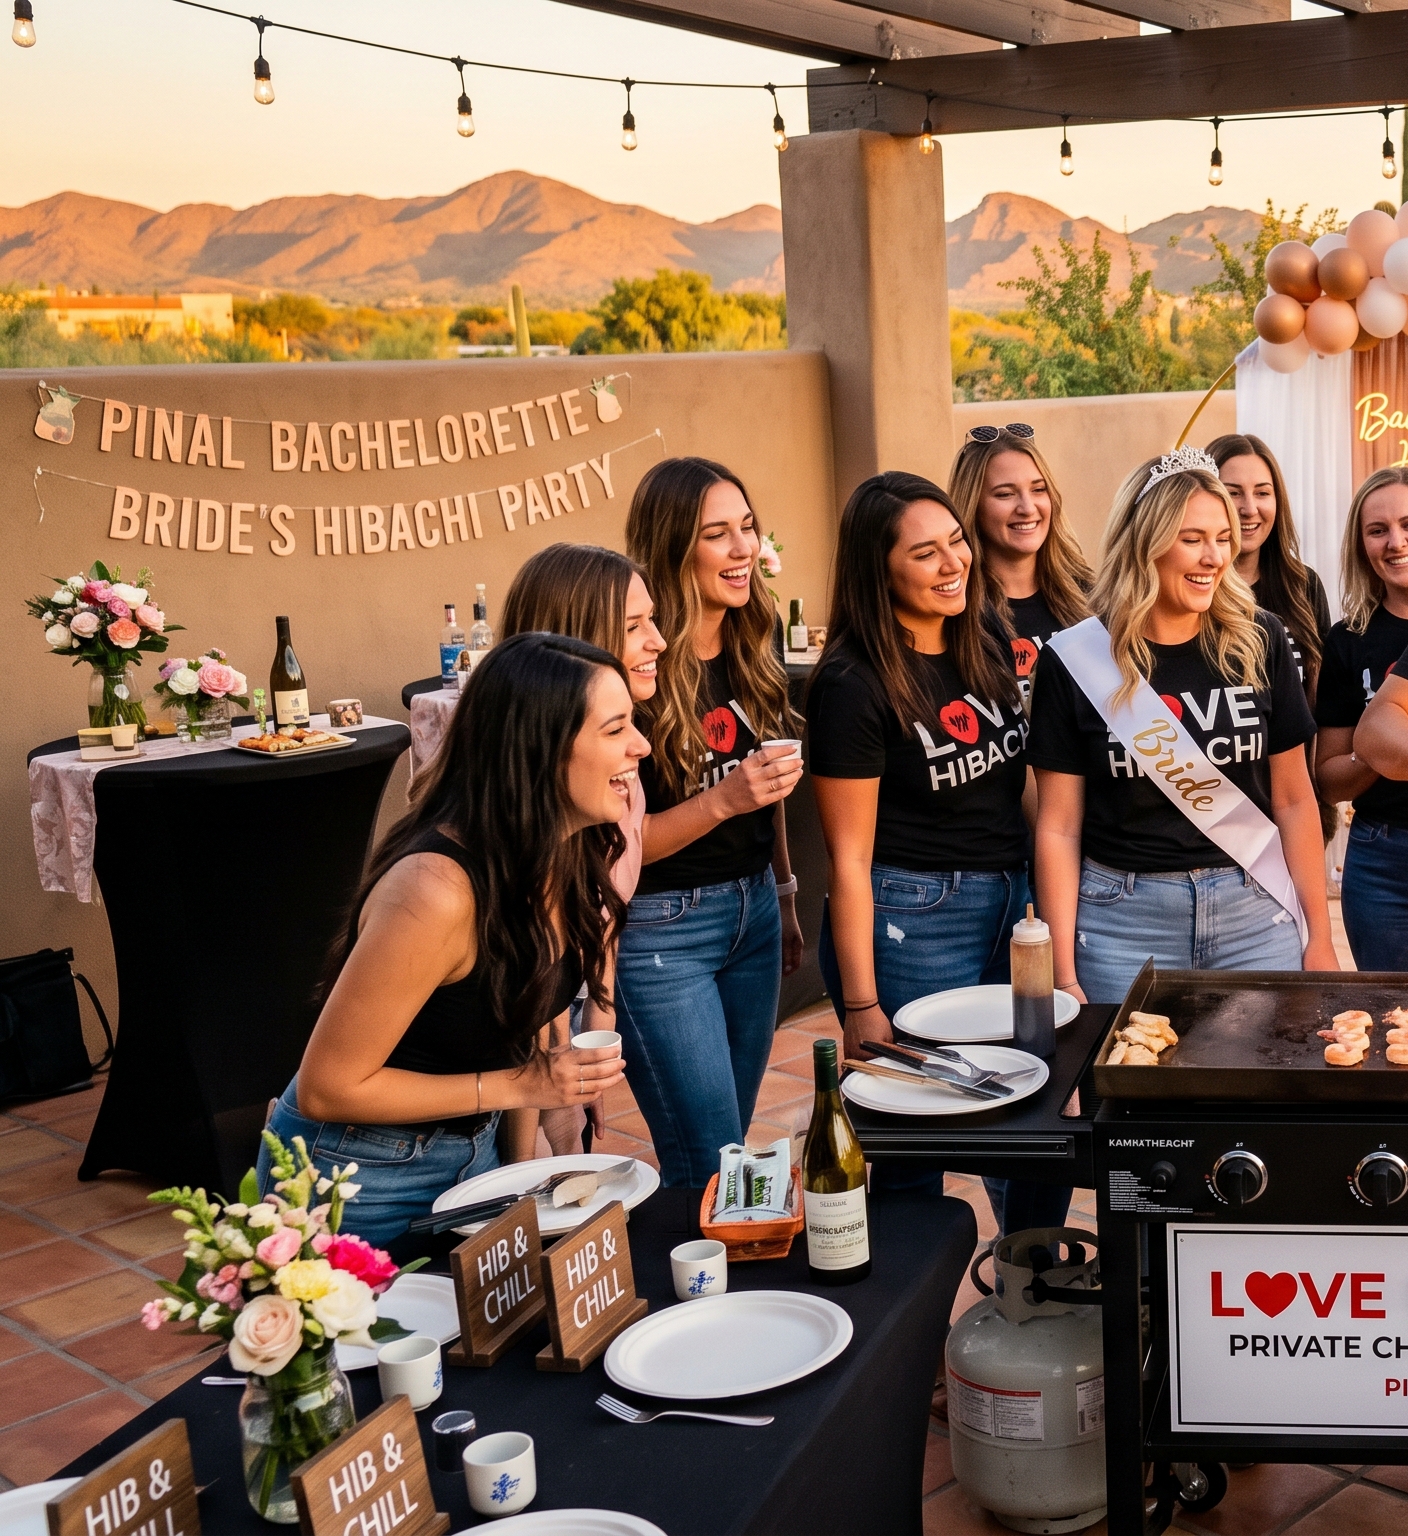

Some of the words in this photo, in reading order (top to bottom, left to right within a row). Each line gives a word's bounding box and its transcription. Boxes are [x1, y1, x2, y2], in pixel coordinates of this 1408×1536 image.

[100, 398, 245, 470] PINAL
[271, 388, 590, 472] BACHELORETTE
[109, 486, 296, 556] BRIDE'S
[315, 493, 483, 556] HIBACHI
[498, 452, 615, 532] PARTY
[1132, 718, 1222, 812] Bride
[477, 1238, 510, 1288] HIB
[514, 1225, 529, 1259] &
[565, 1240, 599, 1291] HIB
[602, 1228, 617, 1261] &
[484, 1264, 536, 1324] CHILL
[573, 1267, 625, 1329] CHILL
[1229, 1334, 1361, 1359] PRIVATE
[85, 1478, 141, 1536] HIB
[148, 1458, 173, 1501] &
[329, 1450, 378, 1514] HIB
[382, 1432, 404, 1473] &
